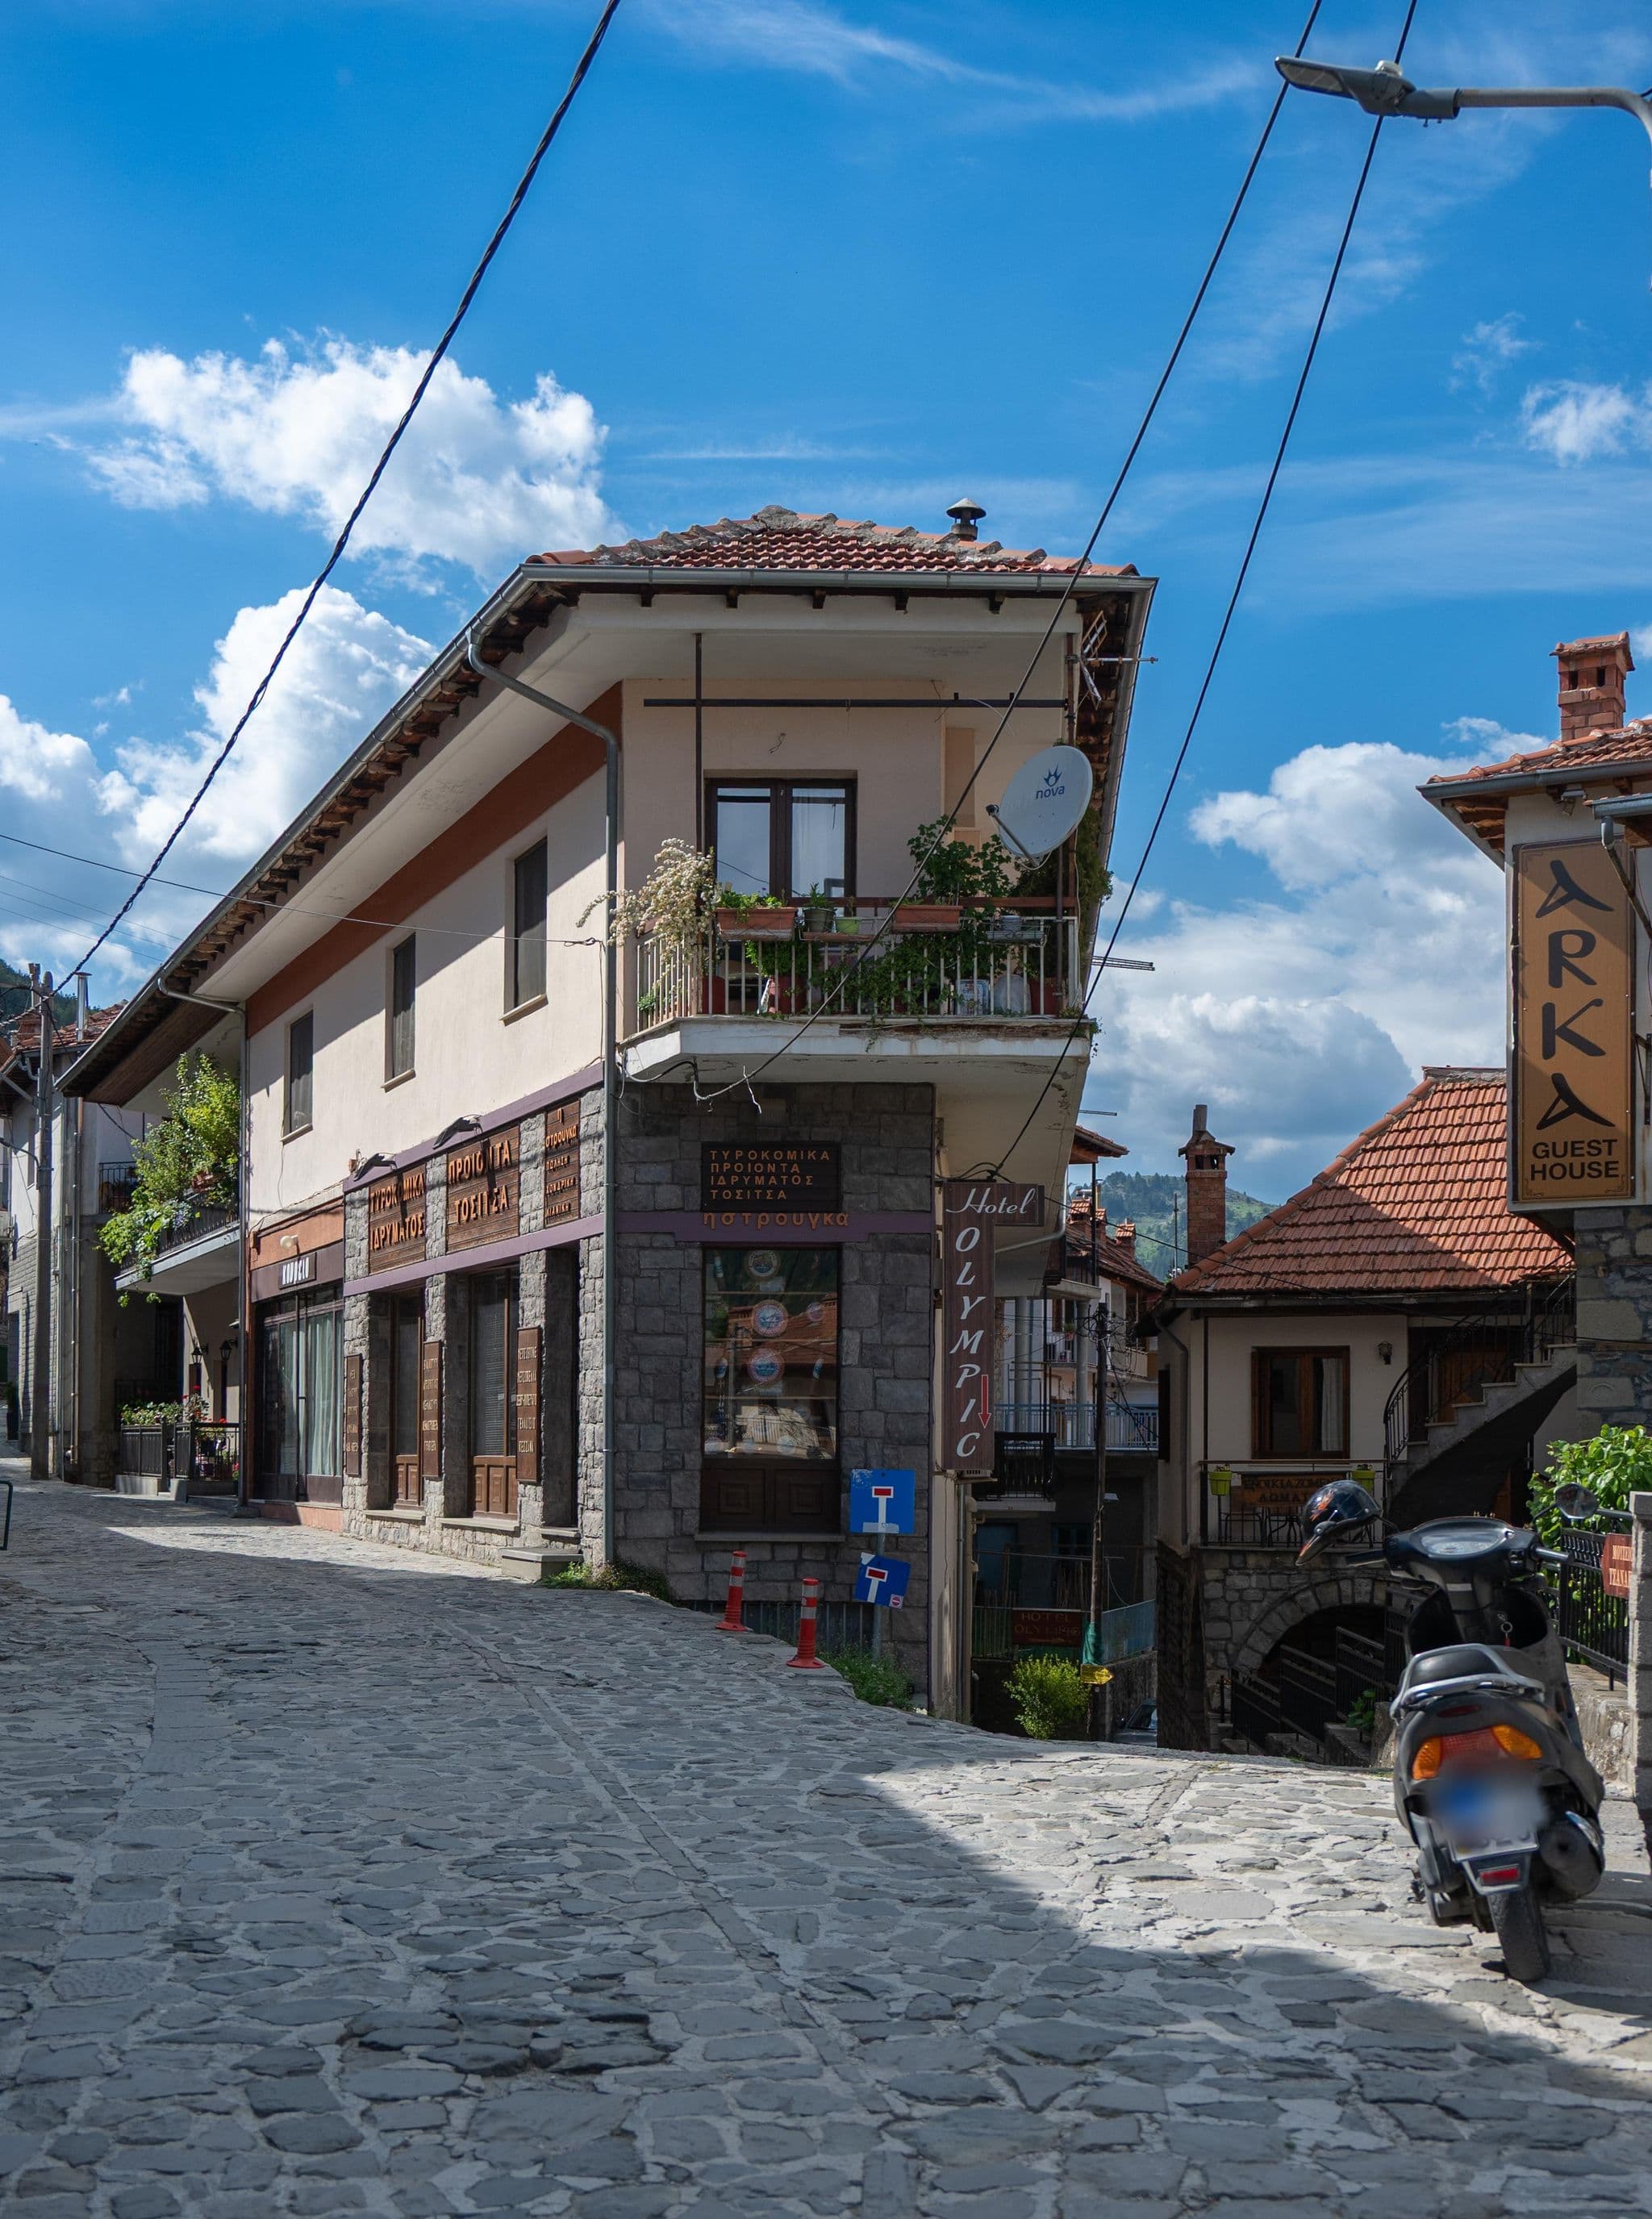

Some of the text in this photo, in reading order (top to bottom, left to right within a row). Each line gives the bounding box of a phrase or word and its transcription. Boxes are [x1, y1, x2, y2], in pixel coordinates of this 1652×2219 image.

[1036, 786, 1065, 799] nova
[1535, 859, 1615, 1131] ARKA
[710, 1150, 830, 1161] ΤΥΡΟΚΟΜΙΚΑ
[1531, 1138, 1618, 1159] GUEST
[711, 1162, 800, 1173] ΠΡΟΙΟΝΤΑ
[1531, 1160, 1620, 1181] HOUSE
[711, 1175, 814, 1186] ΙΔΡΥΜΑΤΟΣ
[710, 1189, 787, 1200] ΤΟΣΙΤΣΑ
[946, 1187, 1037, 1215] Hotel
[371, 1212, 424, 1249] ΙΔΡΥΜΑΤΟΣ
[949, 1226, 987, 1458] OLYMPIC
